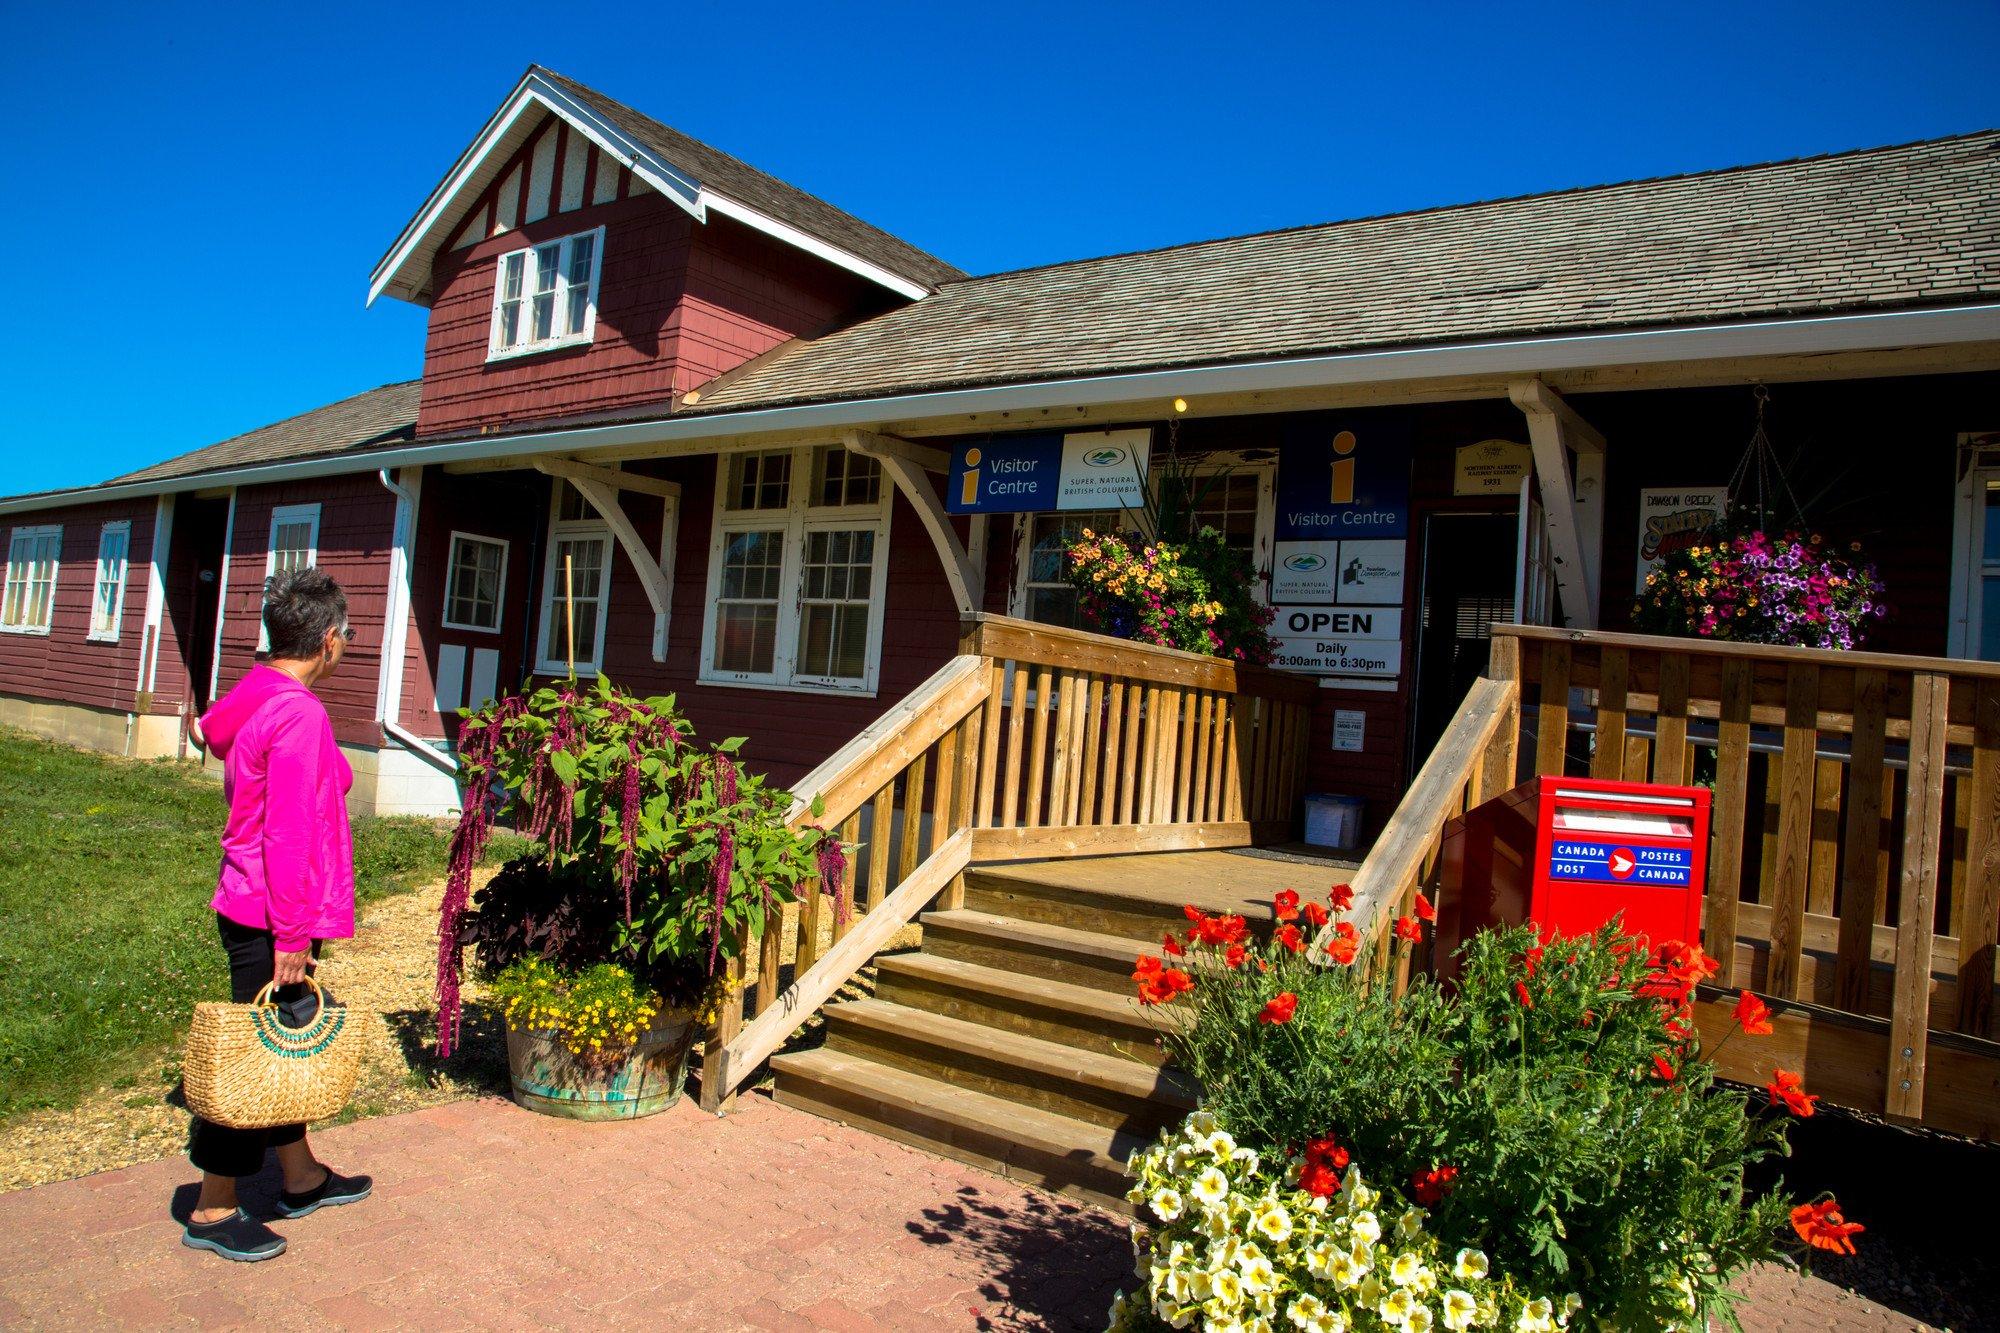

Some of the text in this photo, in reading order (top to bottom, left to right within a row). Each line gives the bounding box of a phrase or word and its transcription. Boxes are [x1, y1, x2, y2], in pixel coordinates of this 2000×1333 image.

[990, 459, 1038, 474] Visitor
[988, 480, 1038, 495] Centre
[1096, 486, 1138, 494] COLUMBIA
[1647, 495, 1716, 506] DAWSON CREEK
[1288, 511, 1396, 526] Visitor Centre
[1288, 612, 1372, 633] OPEN
[1316, 643, 1347, 656] Daily
[1279, 656, 1386, 670] 8:00am to 6:30pm
[1557, 845, 1682, 862] CANADA POSTES
[1556, 864, 1685, 880] POST CANADA
